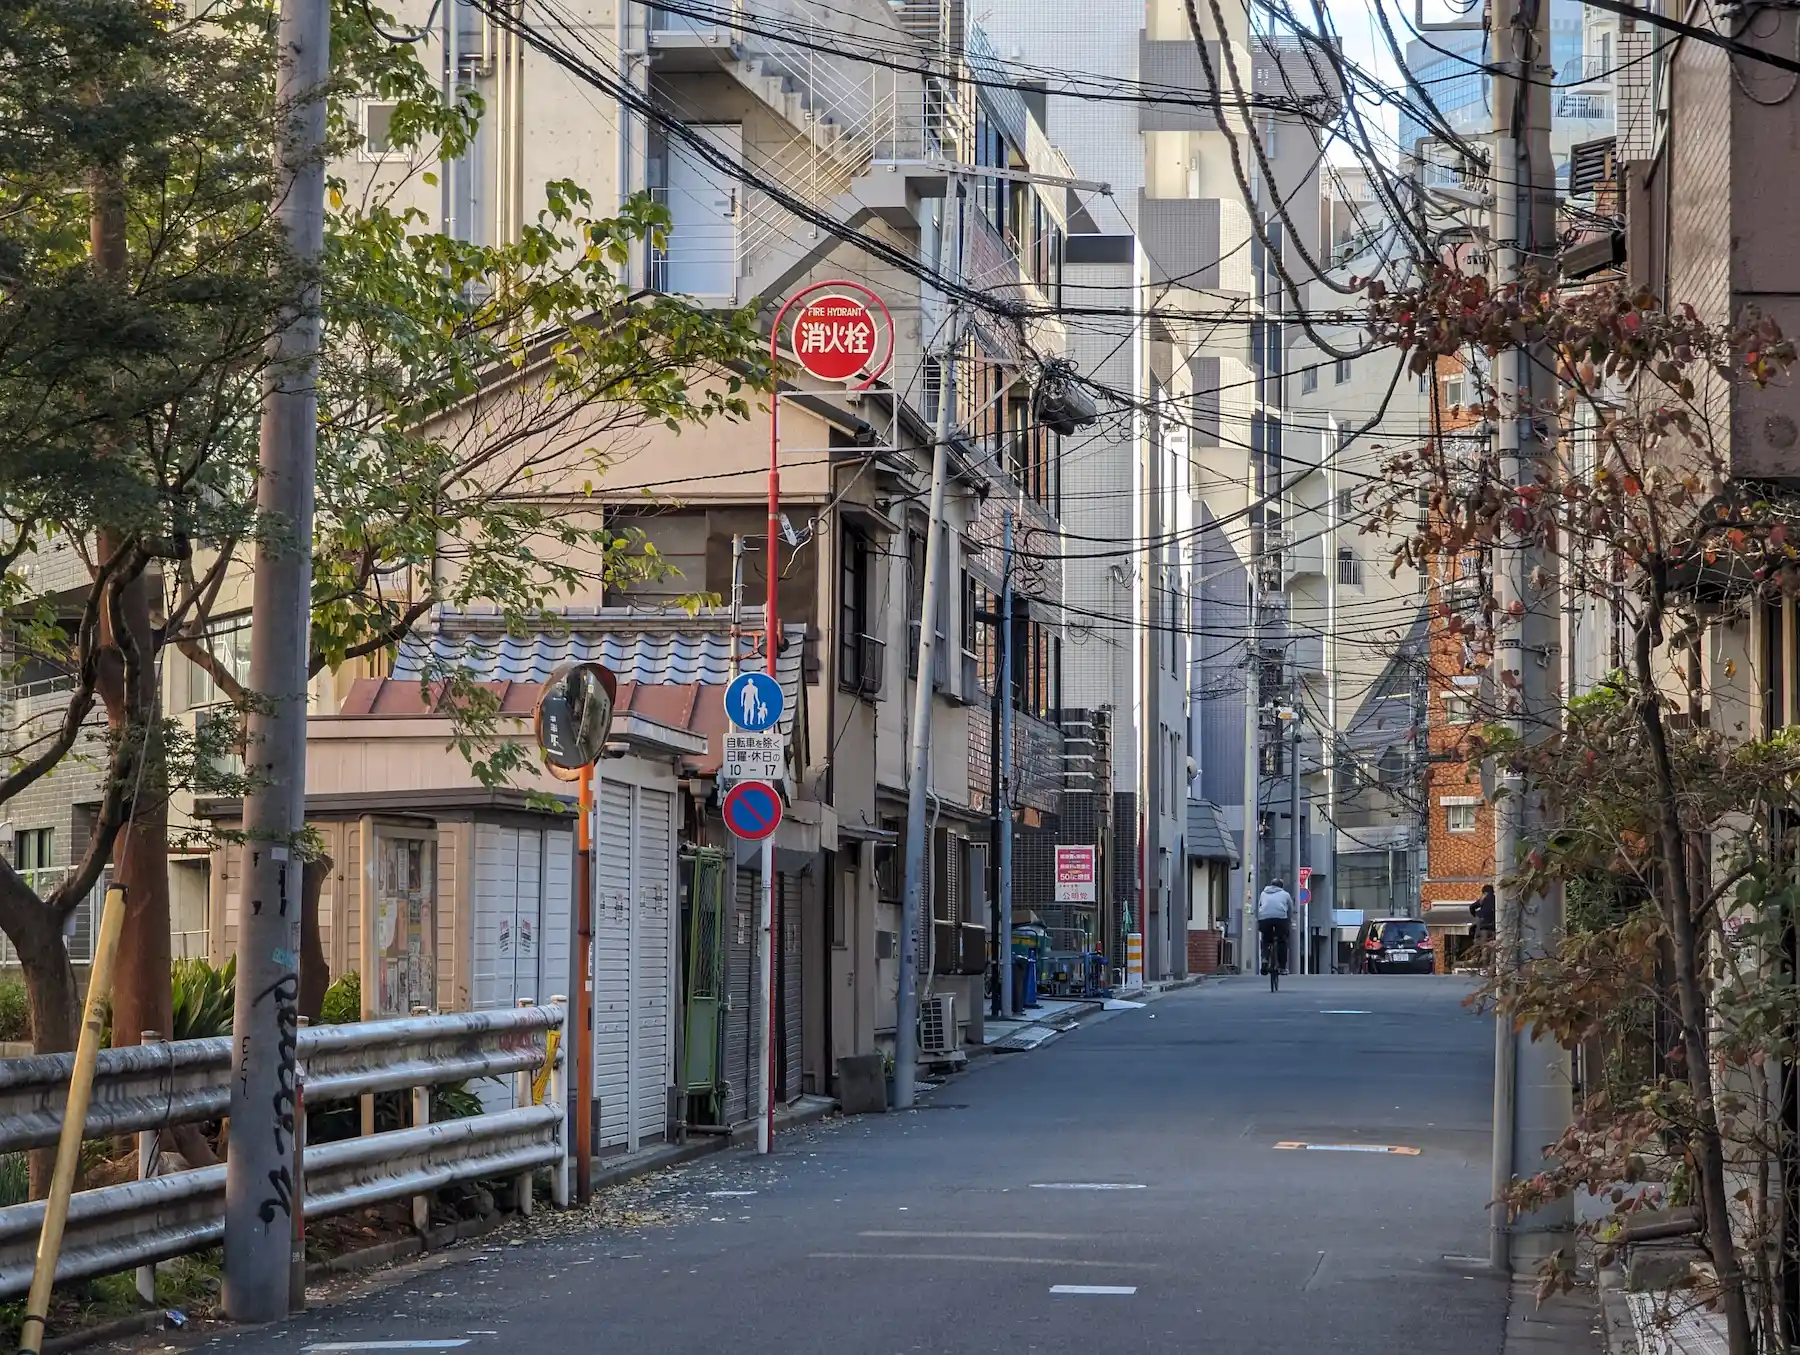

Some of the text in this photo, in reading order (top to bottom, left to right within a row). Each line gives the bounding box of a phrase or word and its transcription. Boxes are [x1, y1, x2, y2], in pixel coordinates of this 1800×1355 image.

[808, 308, 862, 317] FIRE HYDRANT
[801, 322, 870, 353] 消火栓
[727, 737, 780, 748] 自転車を除く
[730, 764, 741, 776] 10
[765, 764, 776, 776] 17
[1063, 892, 1088, 900] 公明党
